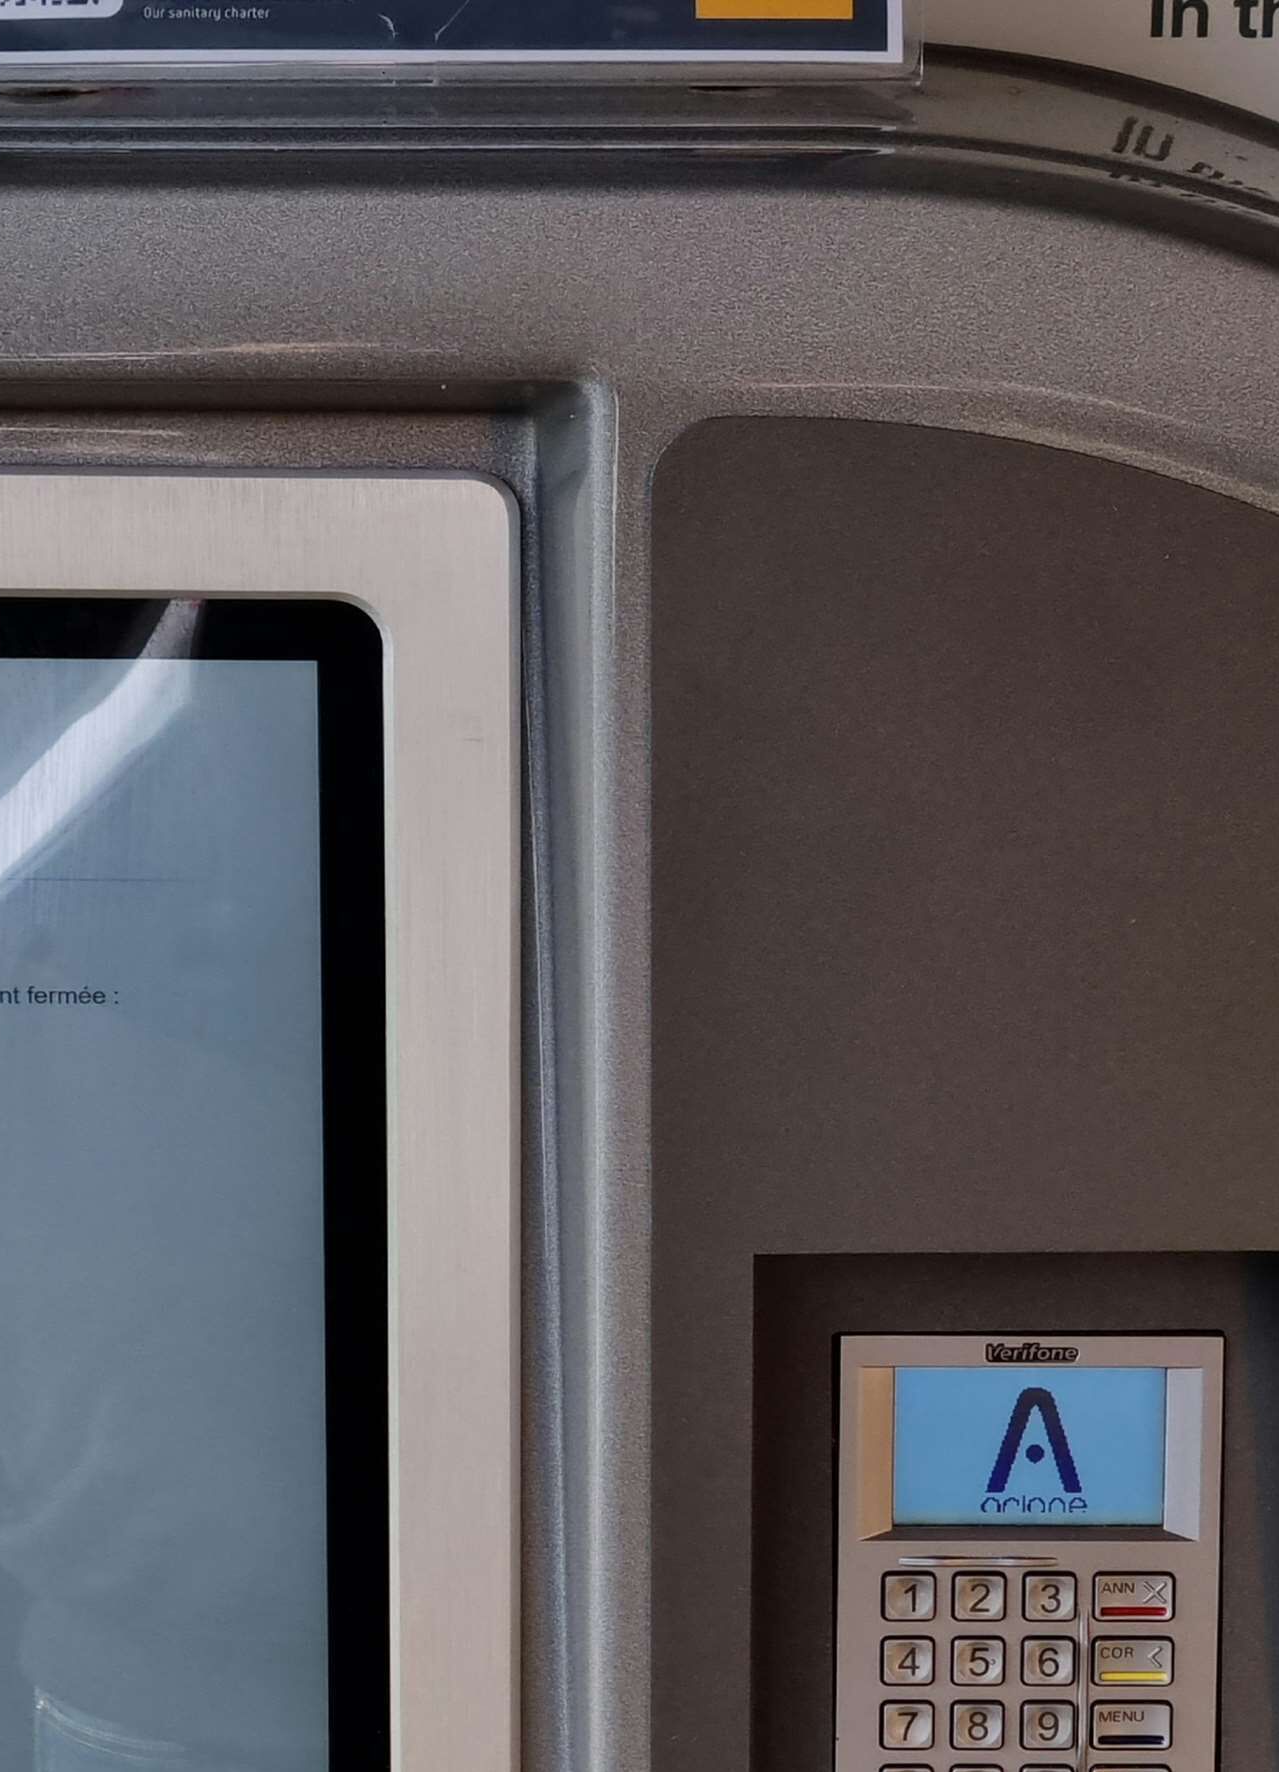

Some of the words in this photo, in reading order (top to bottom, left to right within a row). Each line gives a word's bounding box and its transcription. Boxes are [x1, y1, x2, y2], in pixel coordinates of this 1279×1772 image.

[144, 6, 165, 19] Our
[168, 6, 221, 21] sanitary
[224, 6, 270, 19] charter
[27, 985, 106, 1005] fermée
[986, 1344, 1078, 1362] Verifone
[904, 1583, 918, 1613] 1
[969, 1583, 990, 1613] 2
[1040, 1584, 1061, 1613] 3
[1101, 1582, 1135, 1594] ANN
[897, 1647, 920, 1677] 4
[968, 1647, 990, 1677] 5
[1038, 1647, 1059, 1677] 6
[1100, 1647, 1134, 1659] COR
[897, 1711, 919, 1741] 7
[967, 1711, 989, 1741] 8
[1038, 1711, 1059, 1741] 9
[1098, 1710, 1145, 1723] MENU
